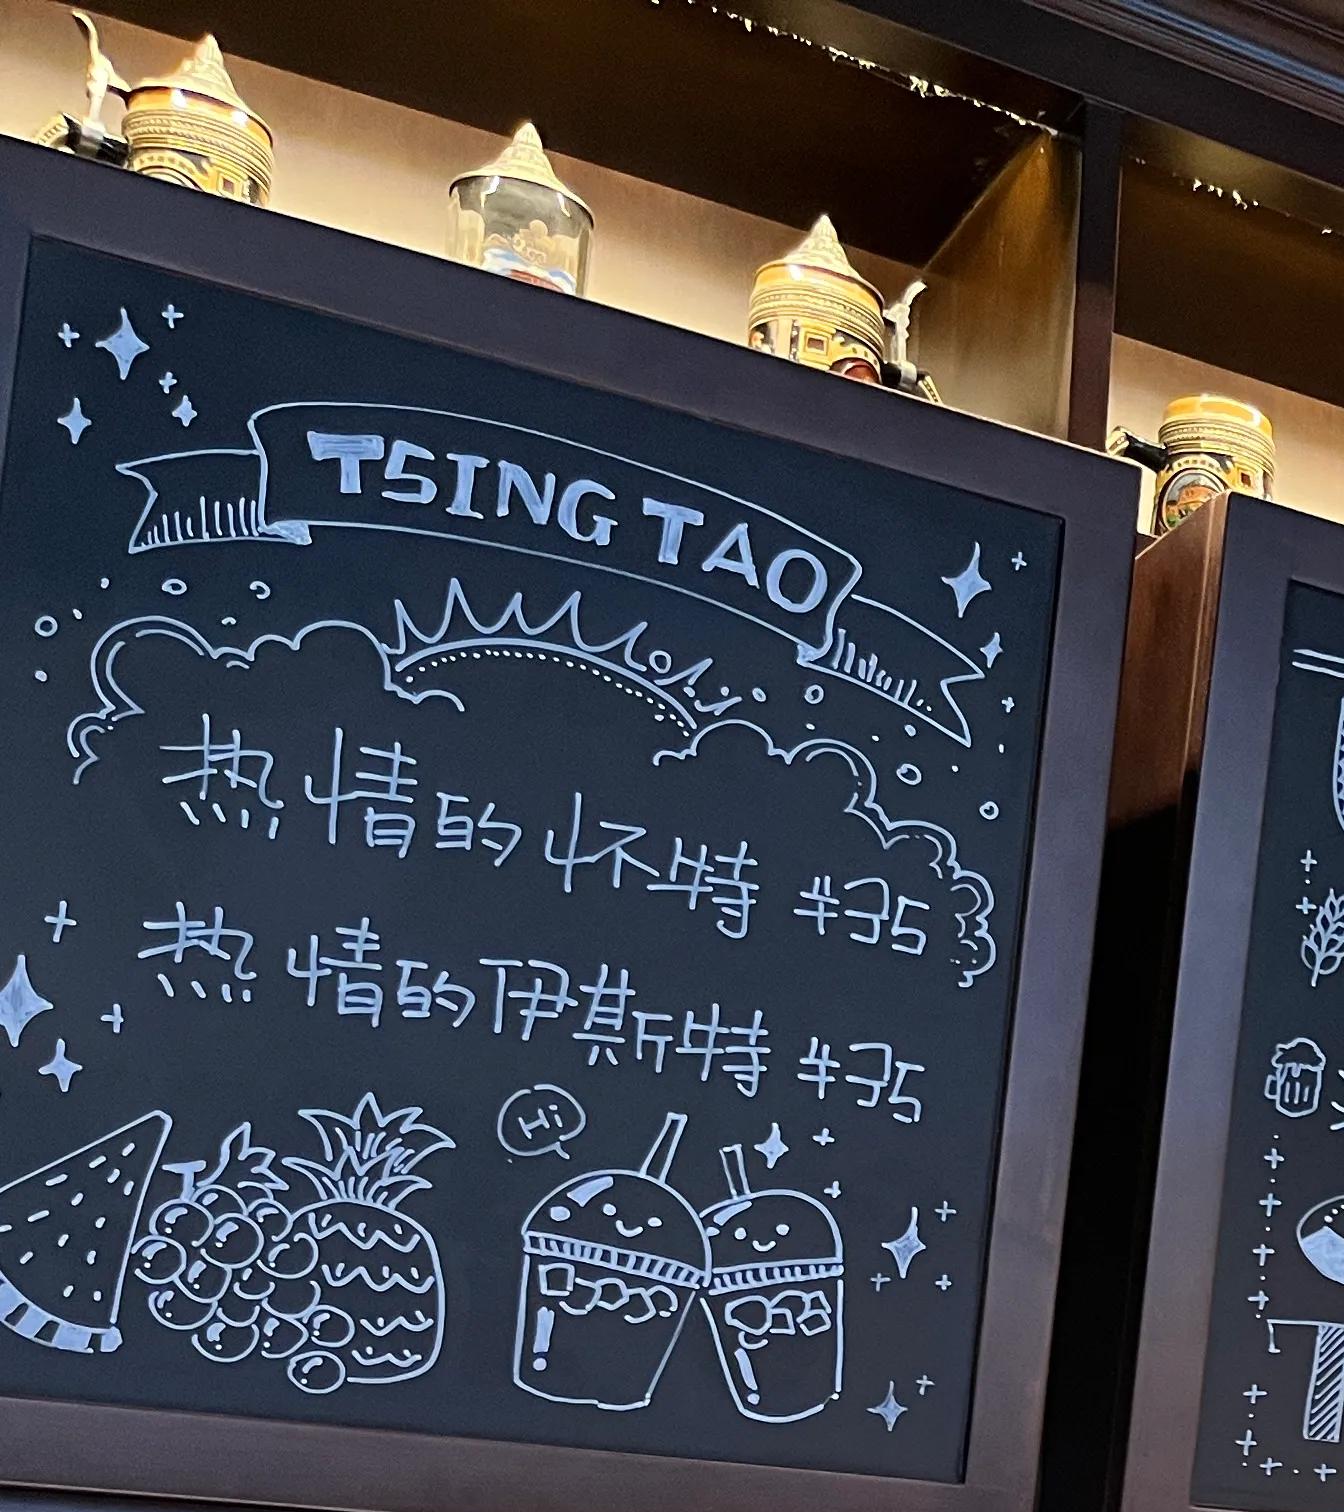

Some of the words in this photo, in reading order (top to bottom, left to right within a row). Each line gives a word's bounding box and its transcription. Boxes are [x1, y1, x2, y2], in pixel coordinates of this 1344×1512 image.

[160, 712, 760, 939] 热情的怀特
[137, 901, 774, 1098] 热情的伊斯特
[517, 1094, 564, 1141] Hi
